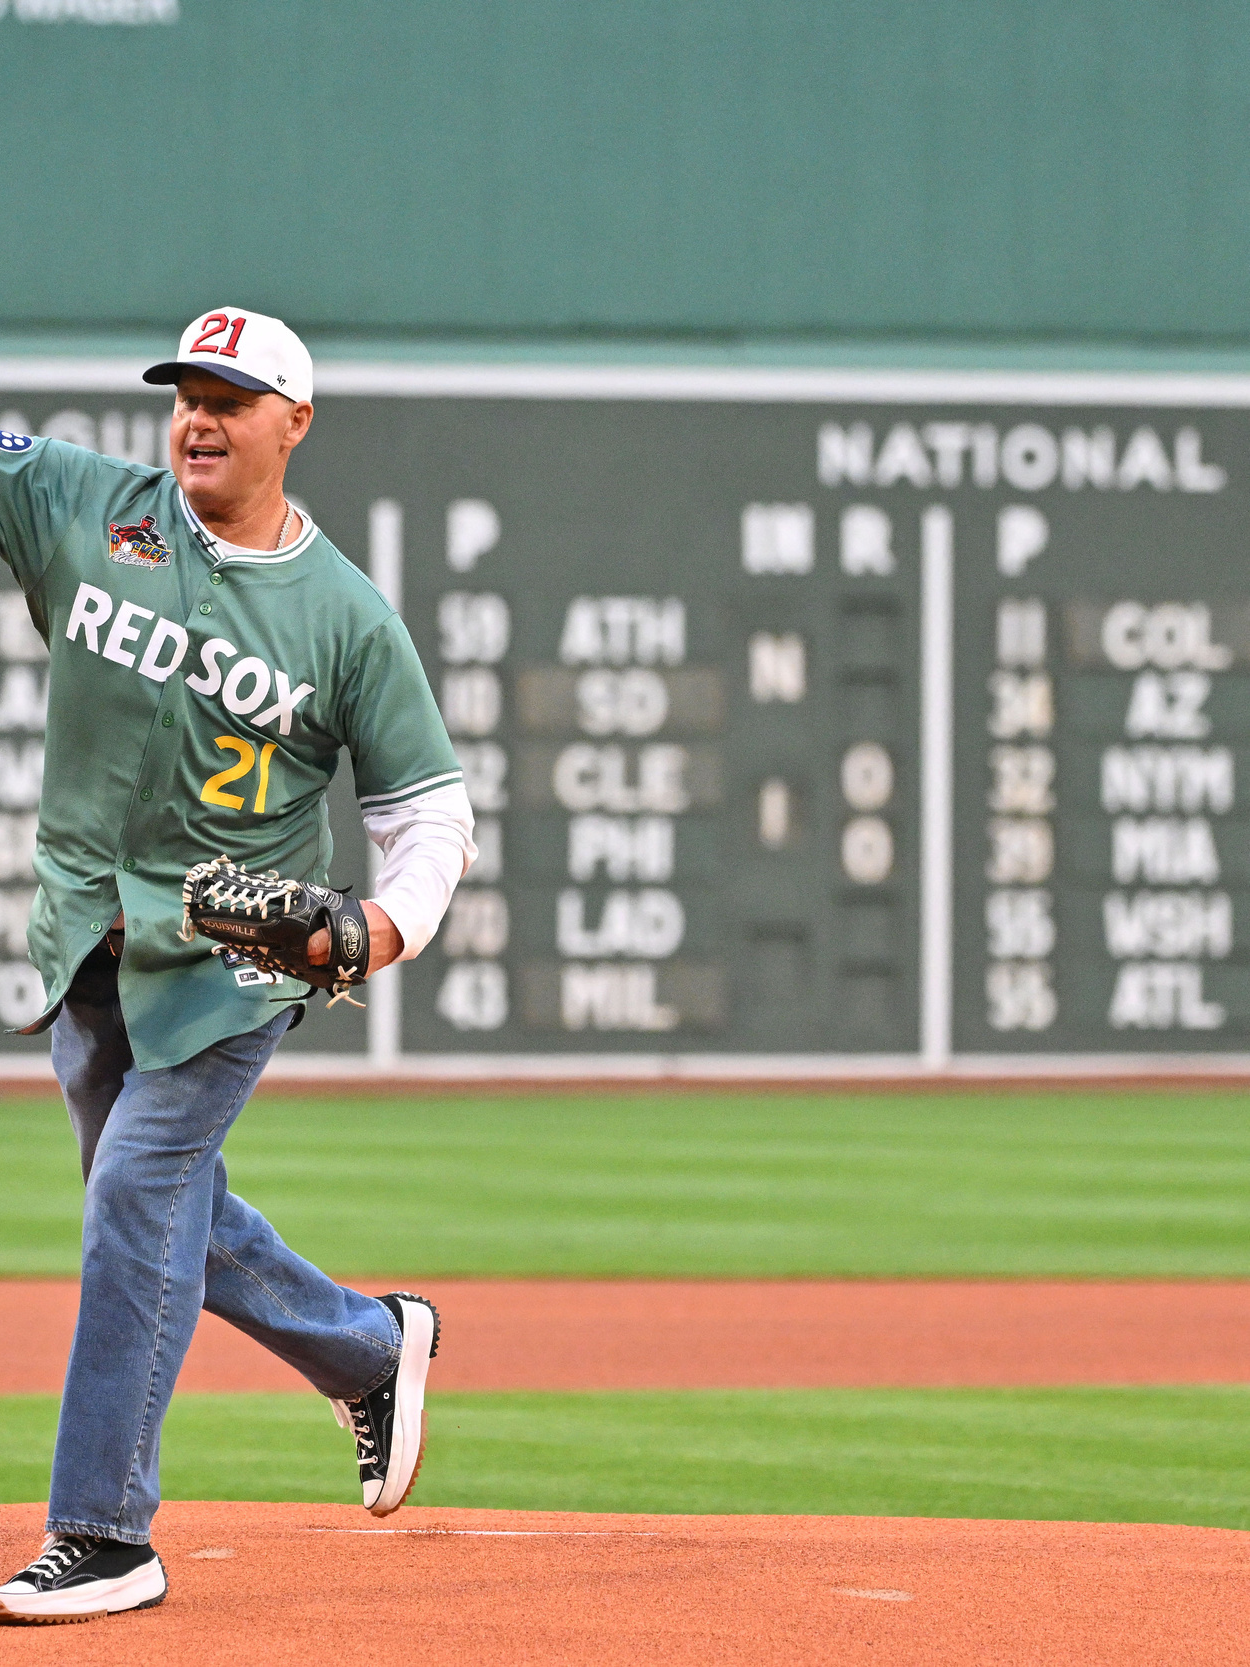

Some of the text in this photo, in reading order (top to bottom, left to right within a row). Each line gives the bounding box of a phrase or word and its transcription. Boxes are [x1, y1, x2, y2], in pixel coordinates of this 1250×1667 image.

[190, 313, 247, 358] 21
[817, 422, 1224, 493] NATIONAL
[447, 500, 499, 570] P
[741, 504, 893, 575] IN R
[997, 506, 1048, 575] P
[65, 582, 315, 737] RED SOX
[560, 596, 686, 663] ATH
[1100, 601, 1230, 671] COL
[575, 667, 671, 736] SD
[749, 636, 805, 702] N
[1126, 671, 1210, 739] AZ
[199, 735, 278, 814] 21
[552, 744, 686, 814] CLE
[840, 743, 893, 811] 0
[1101, 747, 1234, 810] NYM
[568, 813, 675, 881] PHI
[841, 816, 894, 884] 0
[1112, 818, 1219, 883] MIA
[201, 918, 256, 937] LOUISVILLE
[346, 919, 359, 955] Slugger
[556, 889, 685, 958] LAD
[1103, 892, 1233, 959] WSH
[560, 965, 674, 1030] MIL
[1109, 961, 1223, 1029] ATL
